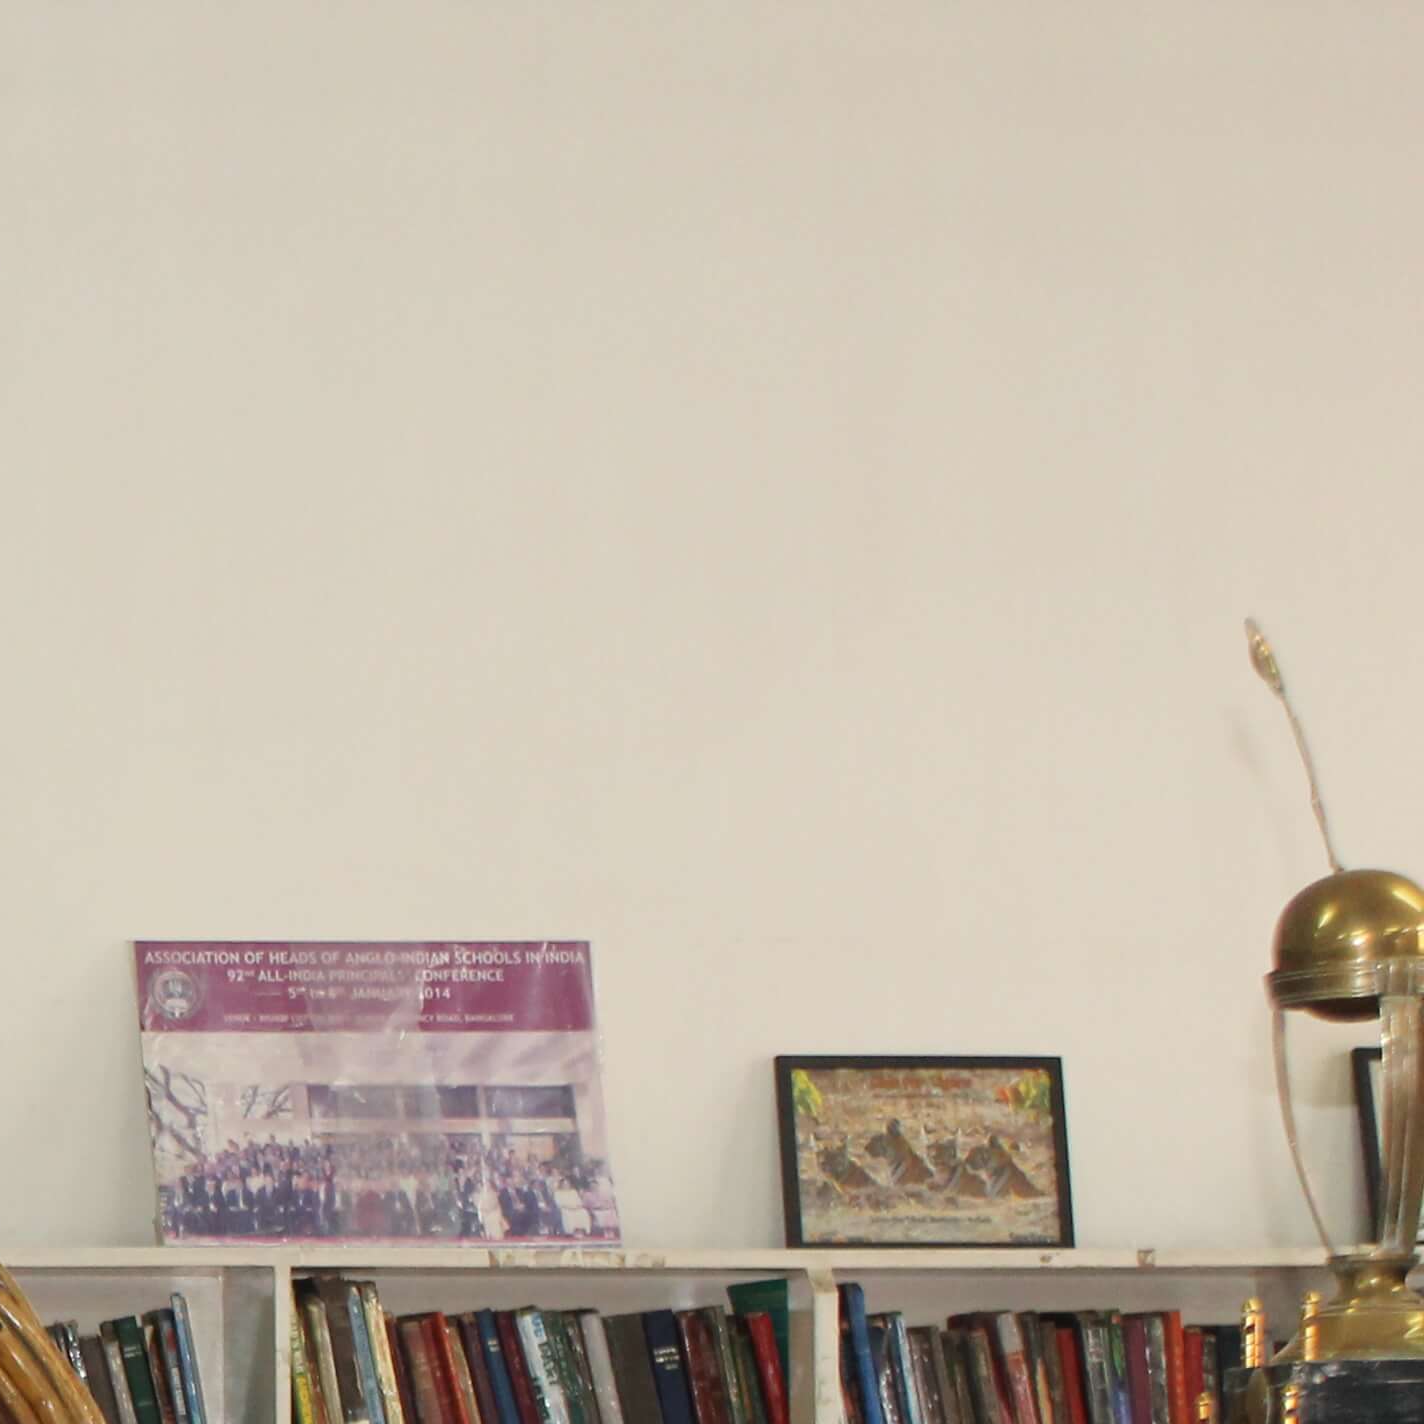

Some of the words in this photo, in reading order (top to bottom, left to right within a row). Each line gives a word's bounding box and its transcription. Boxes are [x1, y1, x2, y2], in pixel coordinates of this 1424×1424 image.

[144, 950, 240, 966] ASSOCIATION
[243, 951, 264, 965] OF
[268, 951, 318, 965] HEADS
[320, 951, 340, 965] OF
[345, 951, 451, 966] ANGLO-INDIAN
[454, 950, 522, 965] SCHOOLS
[525, 951, 541, 965] IN
[543, 951, 585, 965] INDIA
[258, 969, 325, 983] ALL-INDIA
